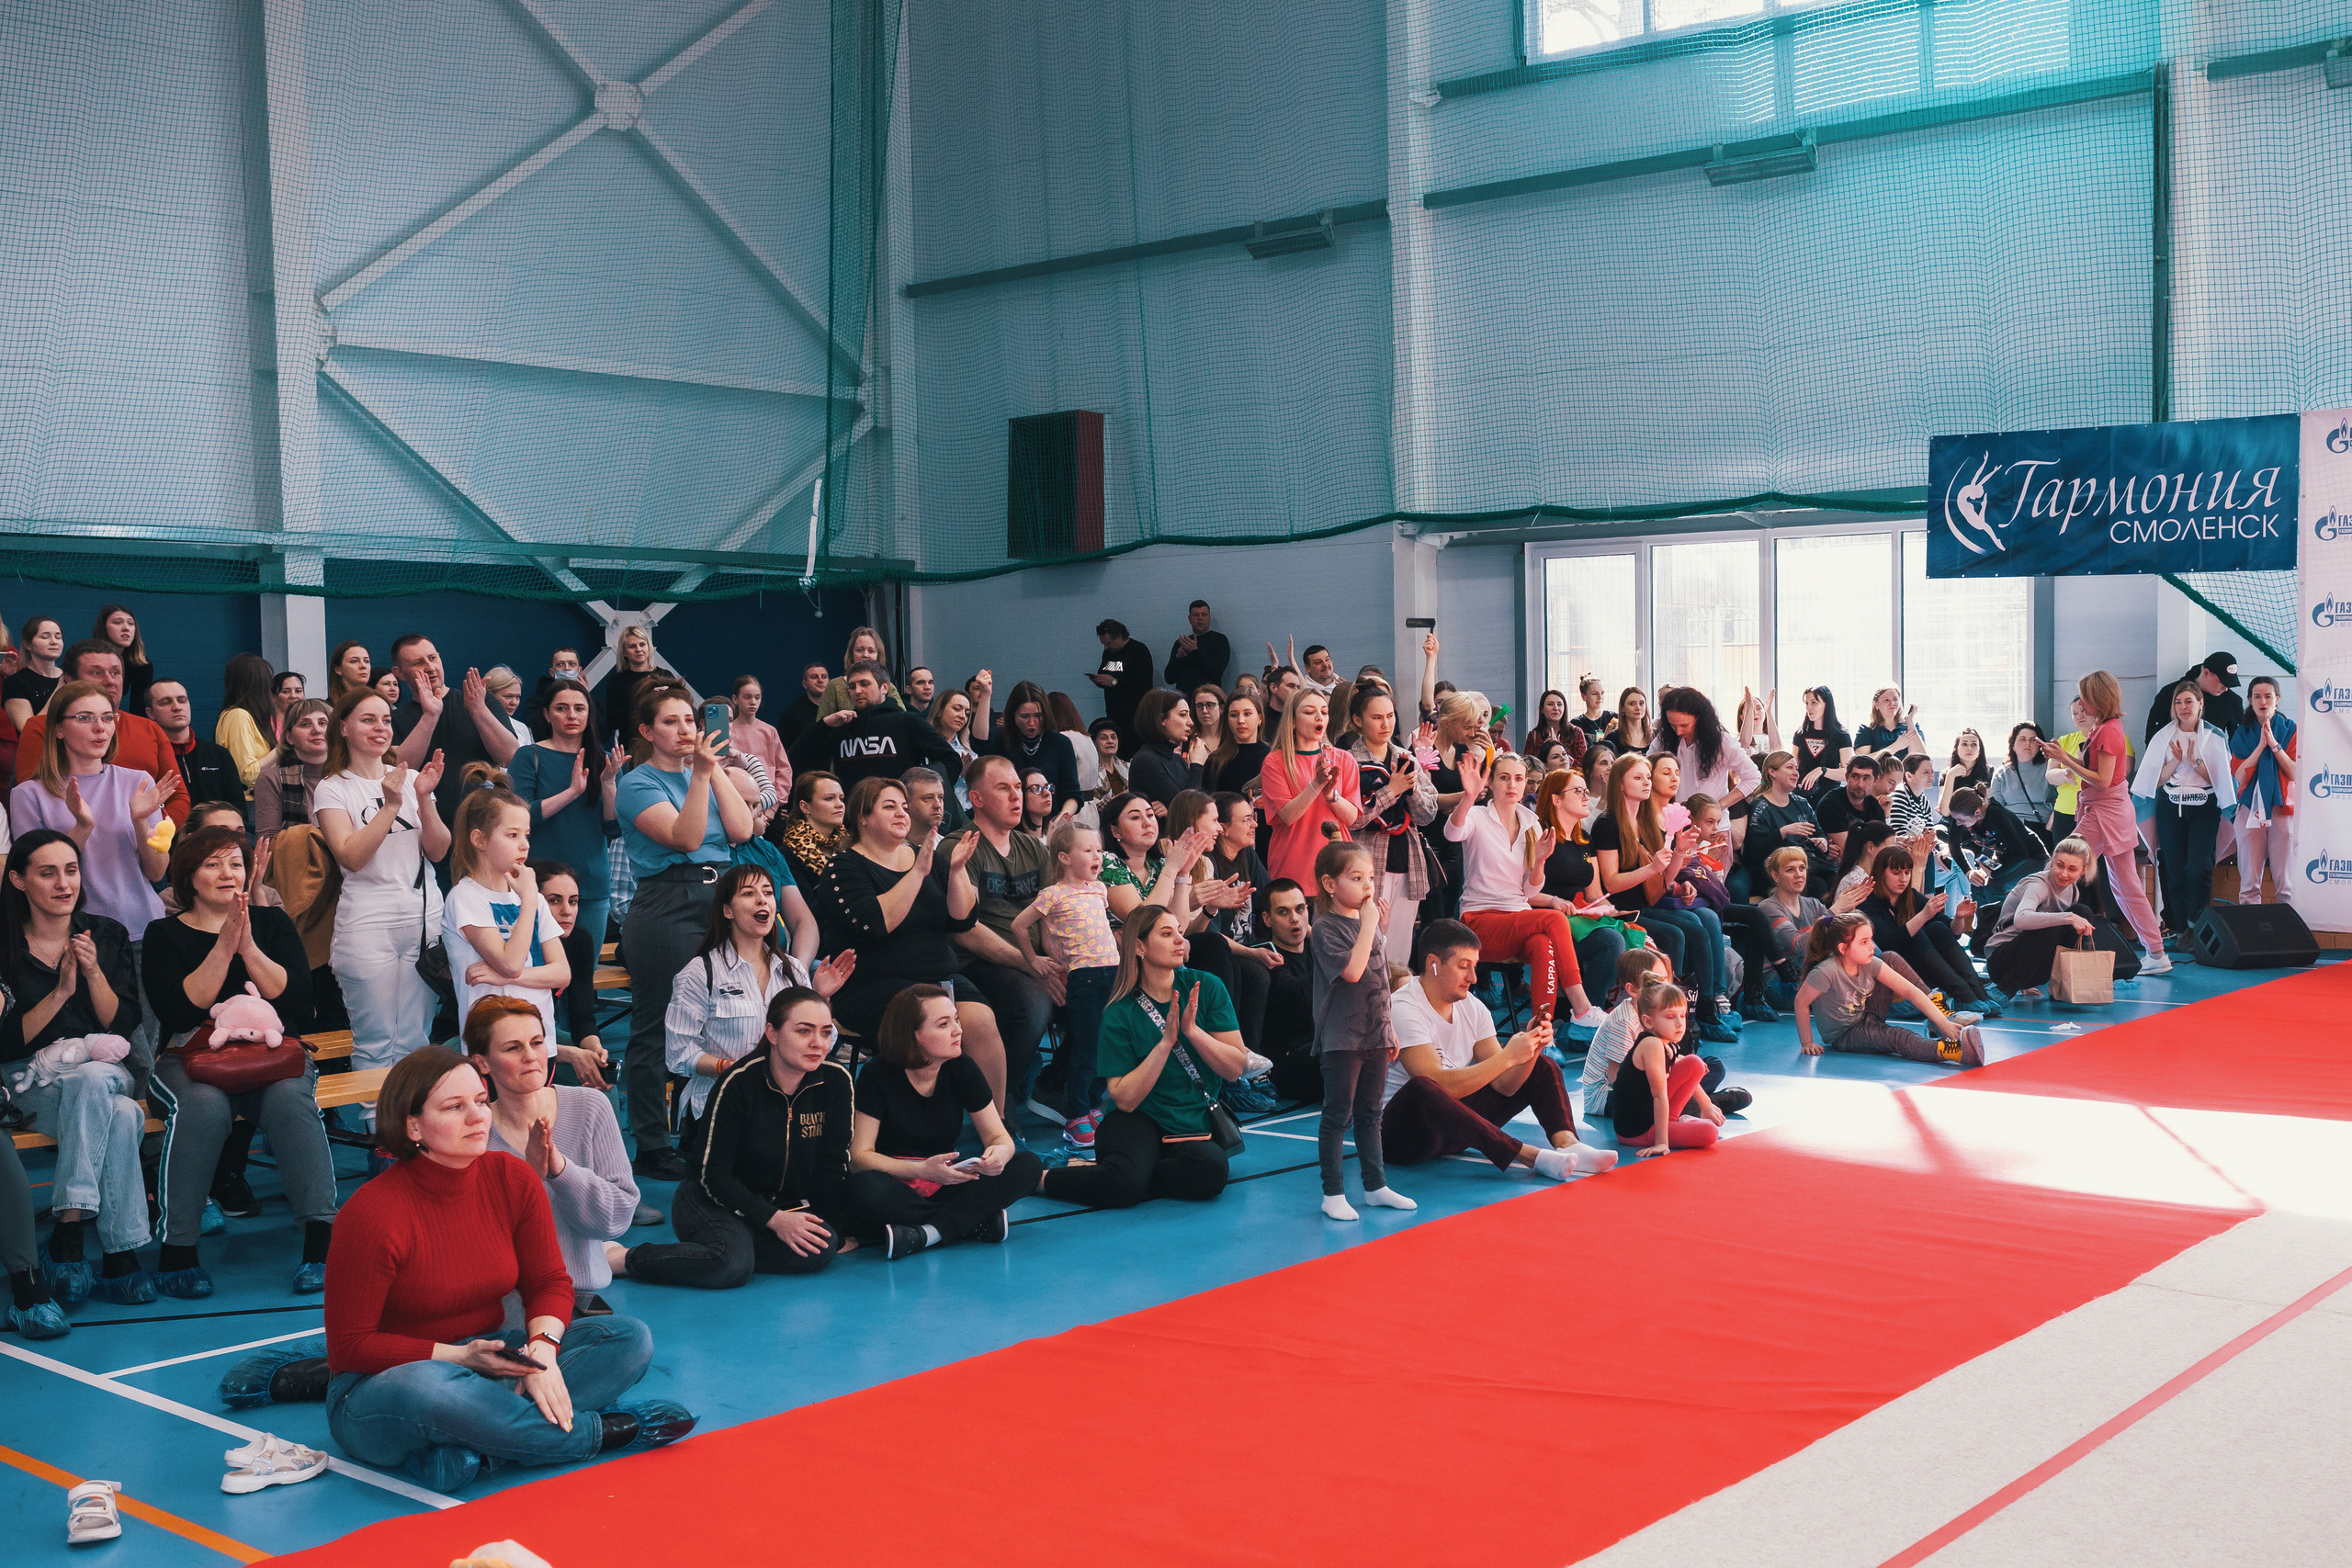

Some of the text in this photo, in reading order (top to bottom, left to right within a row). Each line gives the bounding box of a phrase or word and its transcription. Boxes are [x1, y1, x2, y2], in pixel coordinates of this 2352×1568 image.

[1998, 458, 2281, 536] Гармония
[2110, 513, 2279, 544] СМОЛЕНСК
[2335, 602, 2352, 614] ГАЗ
[840, 736, 898, 759] NASA
[2329, 860, 2352, 871] ГАЗП
[986, 875, 1039, 897] OBSRVE
[1546, 960, 1555, 994] KAPPA
[800, 1123, 823, 1139] STAR
